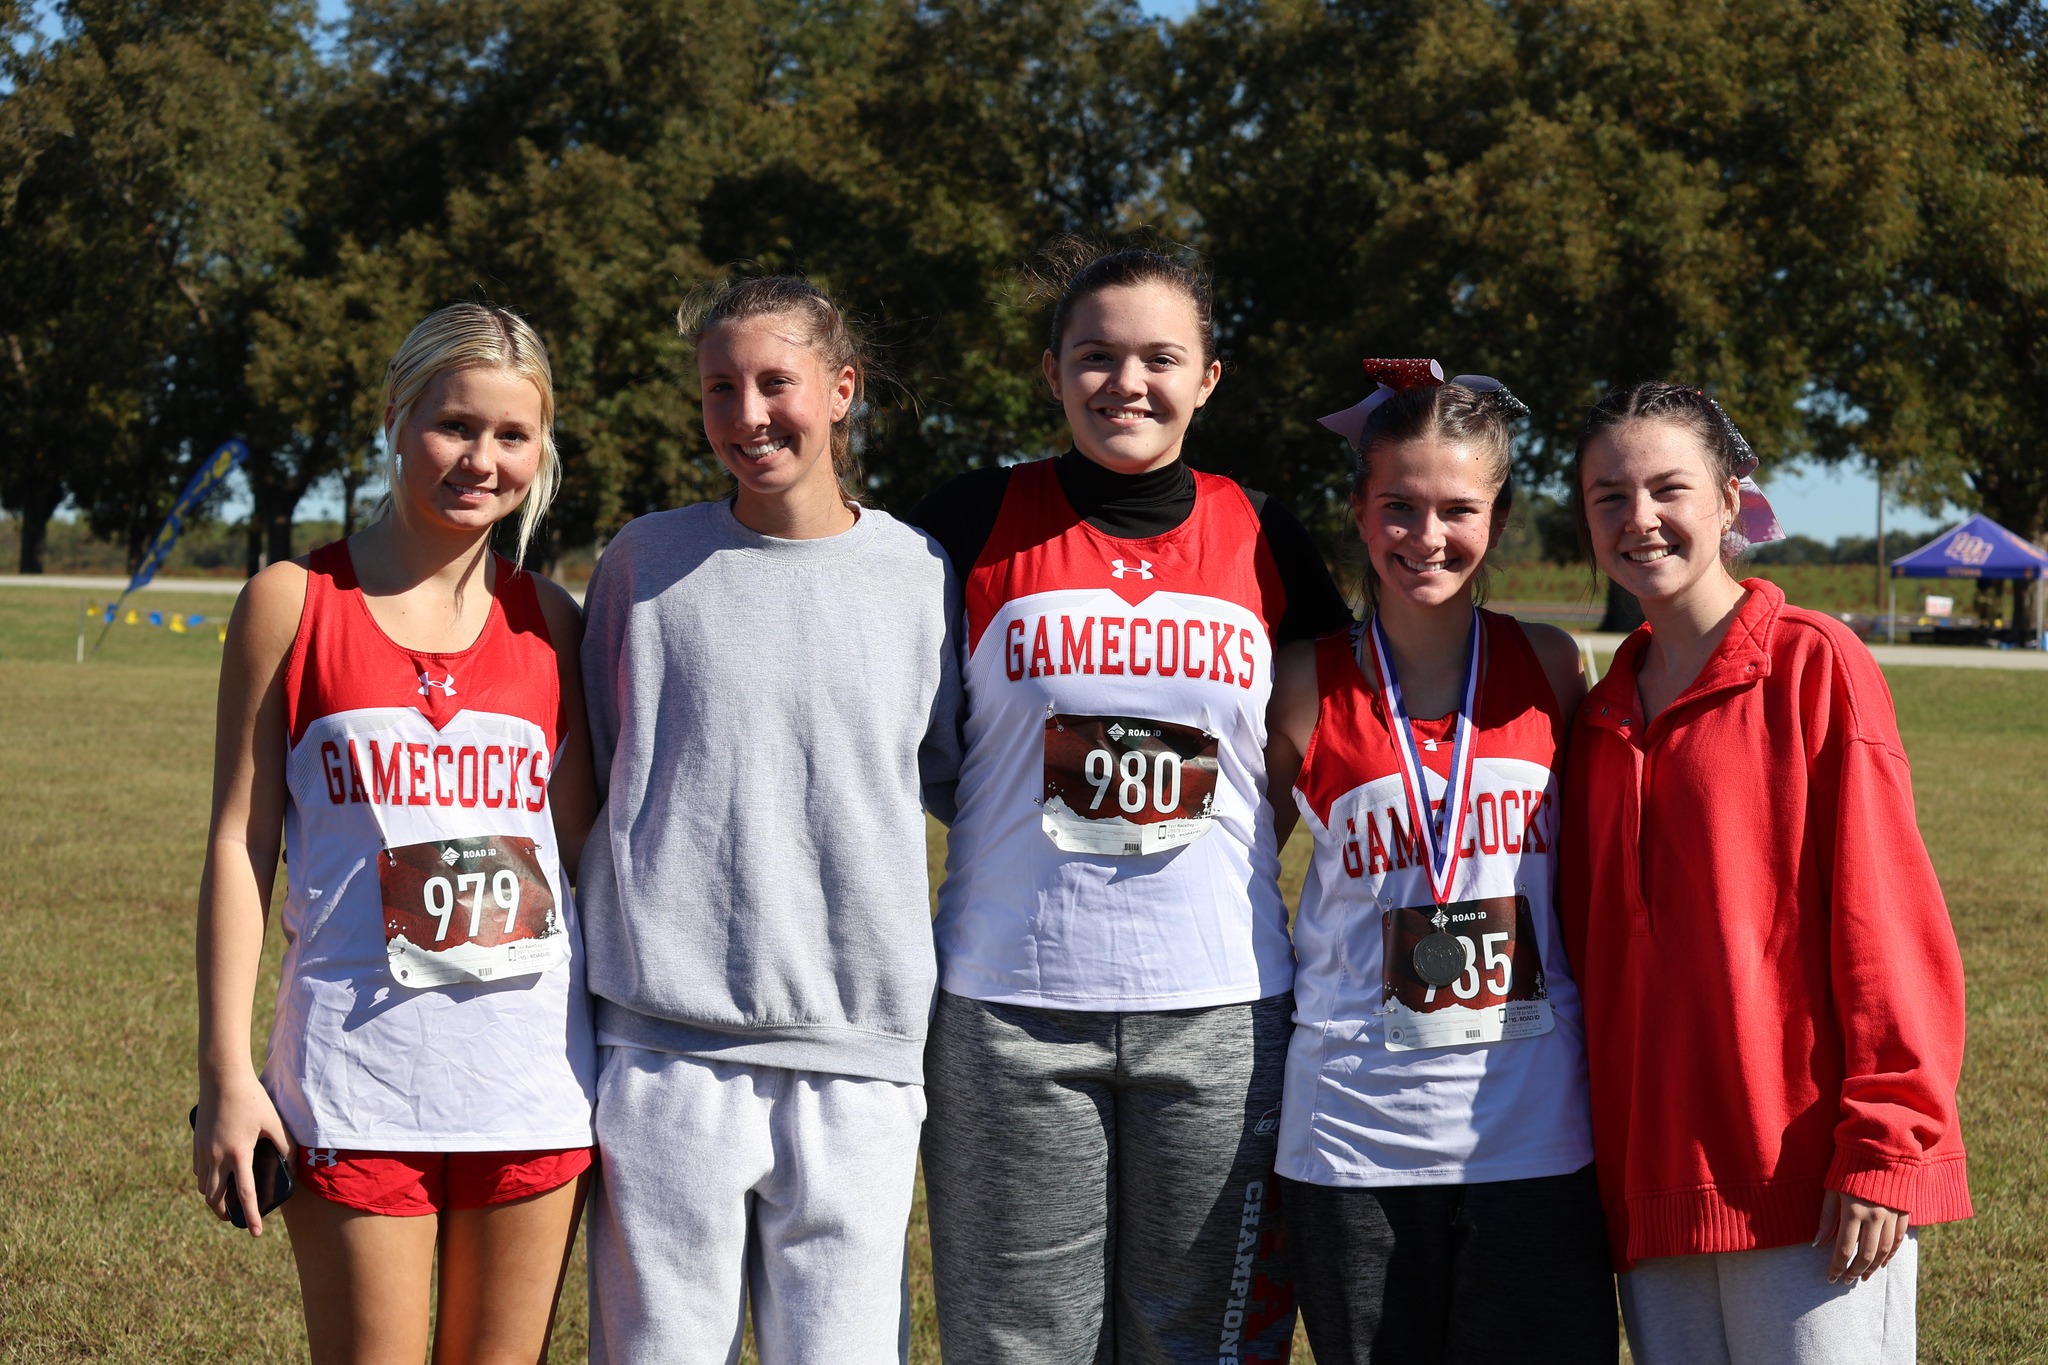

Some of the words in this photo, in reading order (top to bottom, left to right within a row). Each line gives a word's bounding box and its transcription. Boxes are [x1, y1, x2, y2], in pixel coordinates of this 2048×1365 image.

[1005, 615, 1255, 690] GAMECOCKS
[1128, 728, 1151, 737] ROAD
[320, 738, 547, 813] GAMECOCKS
[1084, 749, 1182, 814] 980
[463, 849, 487, 859] ROAD
[423, 869, 520, 942] 979
[1452, 912, 1476, 923] ROAD
[1424, 931, 1514, 1004] 85
